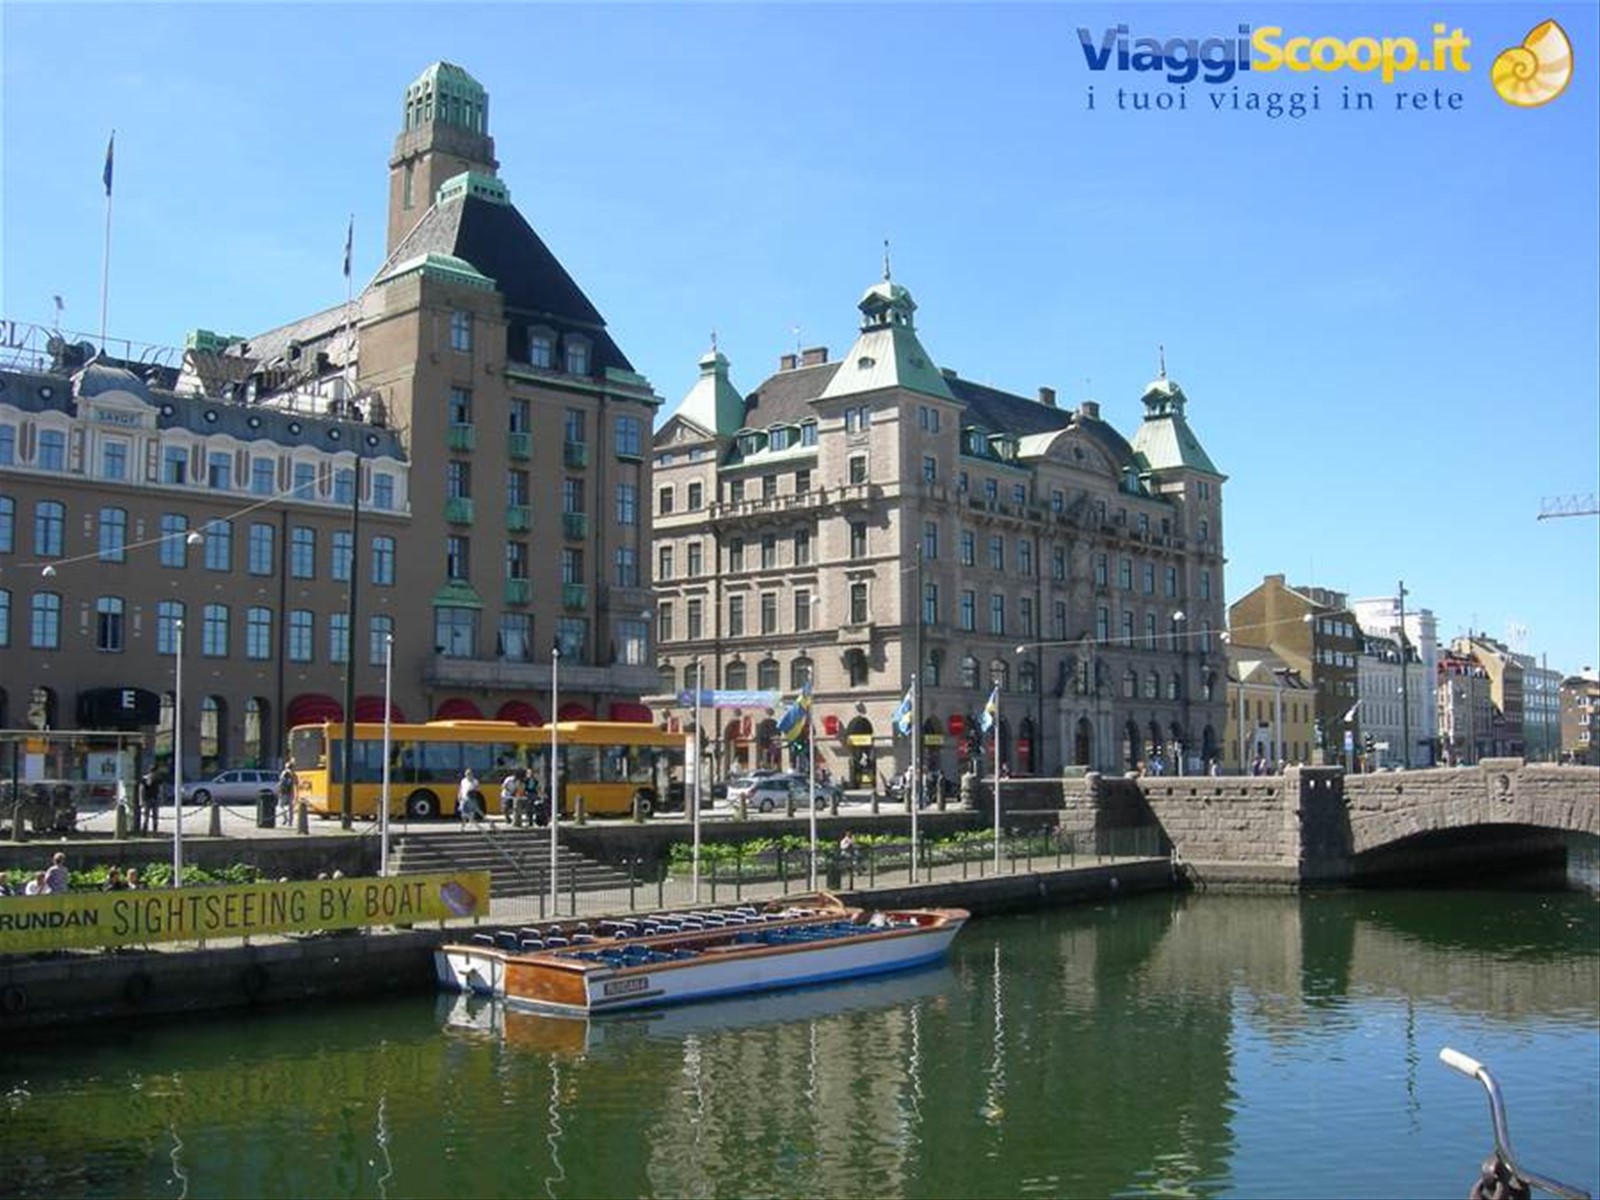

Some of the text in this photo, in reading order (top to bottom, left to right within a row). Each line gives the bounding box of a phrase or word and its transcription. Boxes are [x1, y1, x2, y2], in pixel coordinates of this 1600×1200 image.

[122, 690, 136, 708] E
[0, 882, 426, 936] RUNDAN SIGHTSEEING BY BOAT
